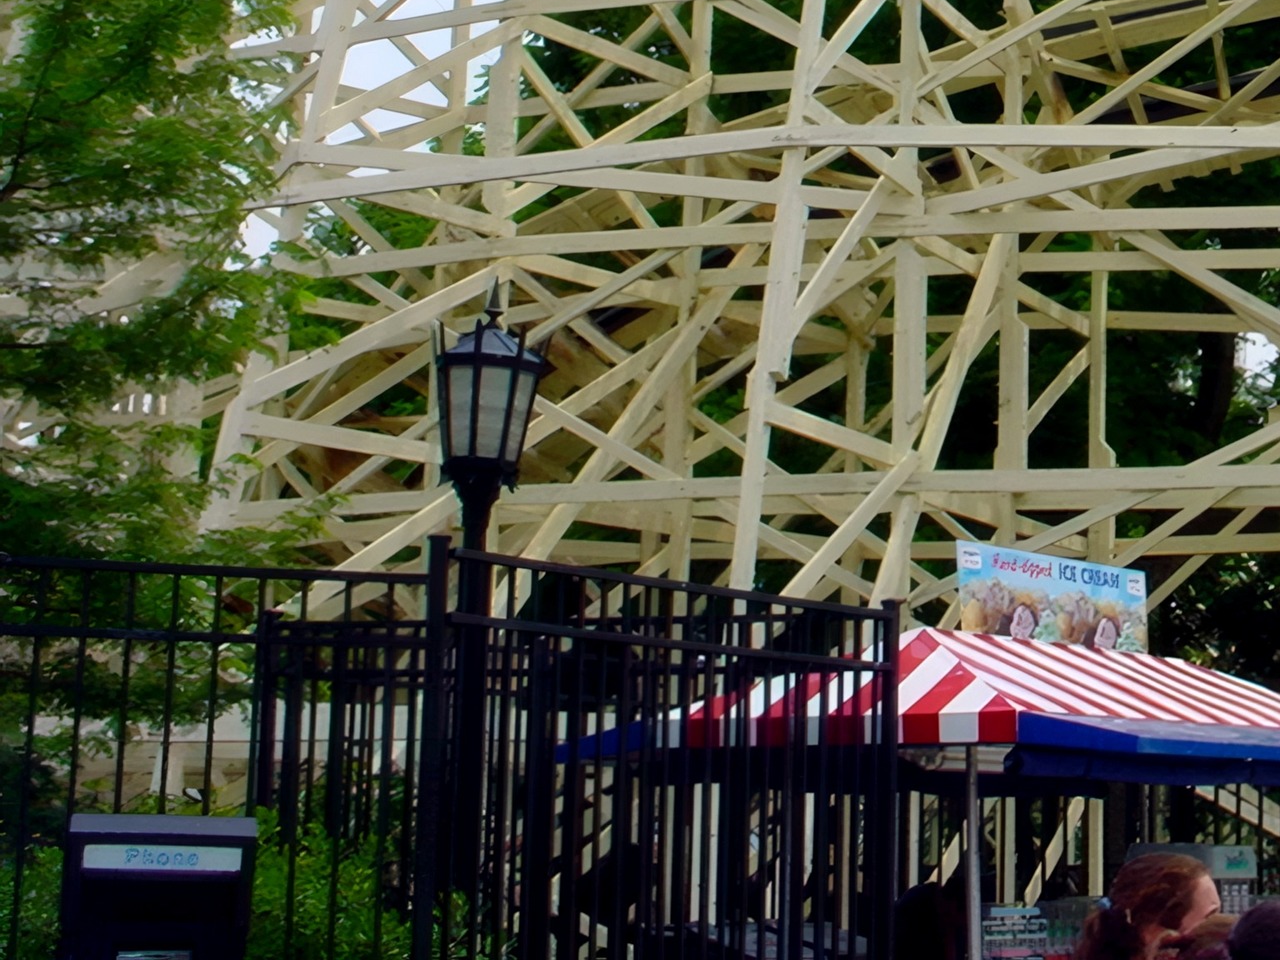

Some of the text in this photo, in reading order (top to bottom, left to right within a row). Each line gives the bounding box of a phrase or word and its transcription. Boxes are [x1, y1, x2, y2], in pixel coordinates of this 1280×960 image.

[1058, 562, 1077, 583] ICE
[1081, 567, 1120, 589] CREAM
[124, 847, 199, 866] Phone
